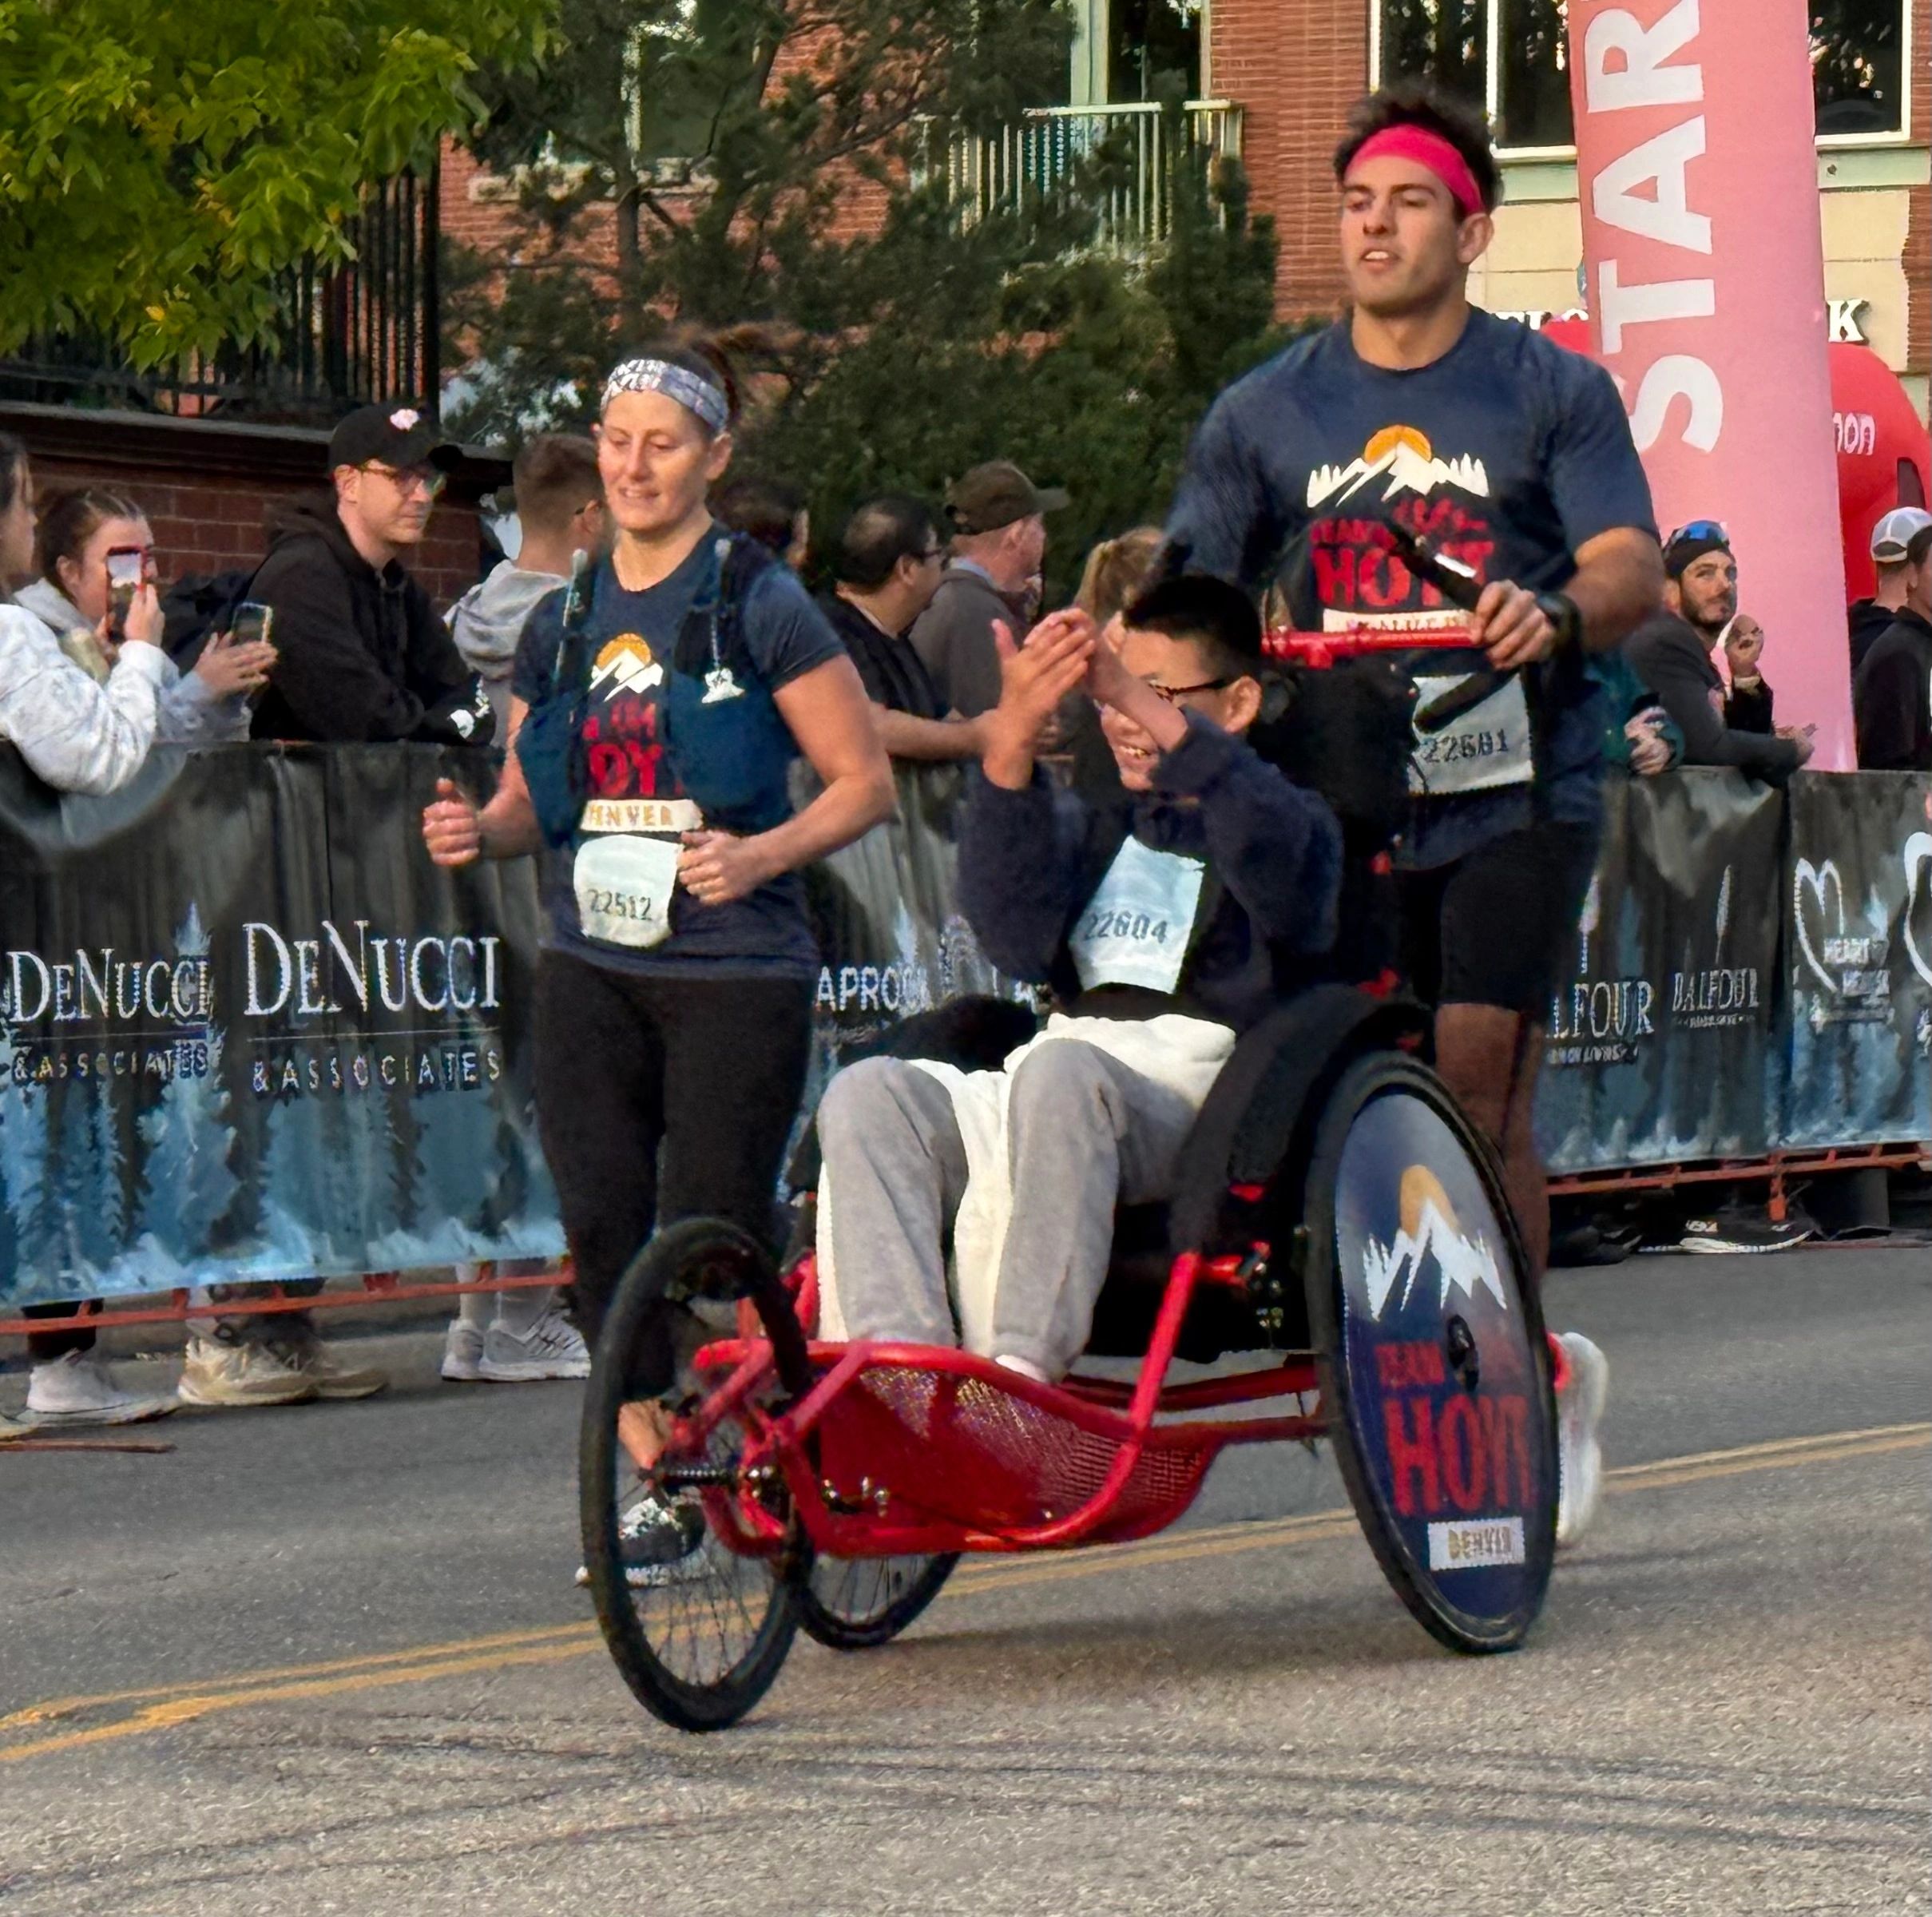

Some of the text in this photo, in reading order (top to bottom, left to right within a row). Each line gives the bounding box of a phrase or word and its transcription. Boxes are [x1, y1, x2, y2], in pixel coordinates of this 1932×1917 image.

[586, 888, 653, 921] 22512
[1083, 909, 1168, 944] 22604
[282, 1049, 500, 1090] ASSOCIATES
